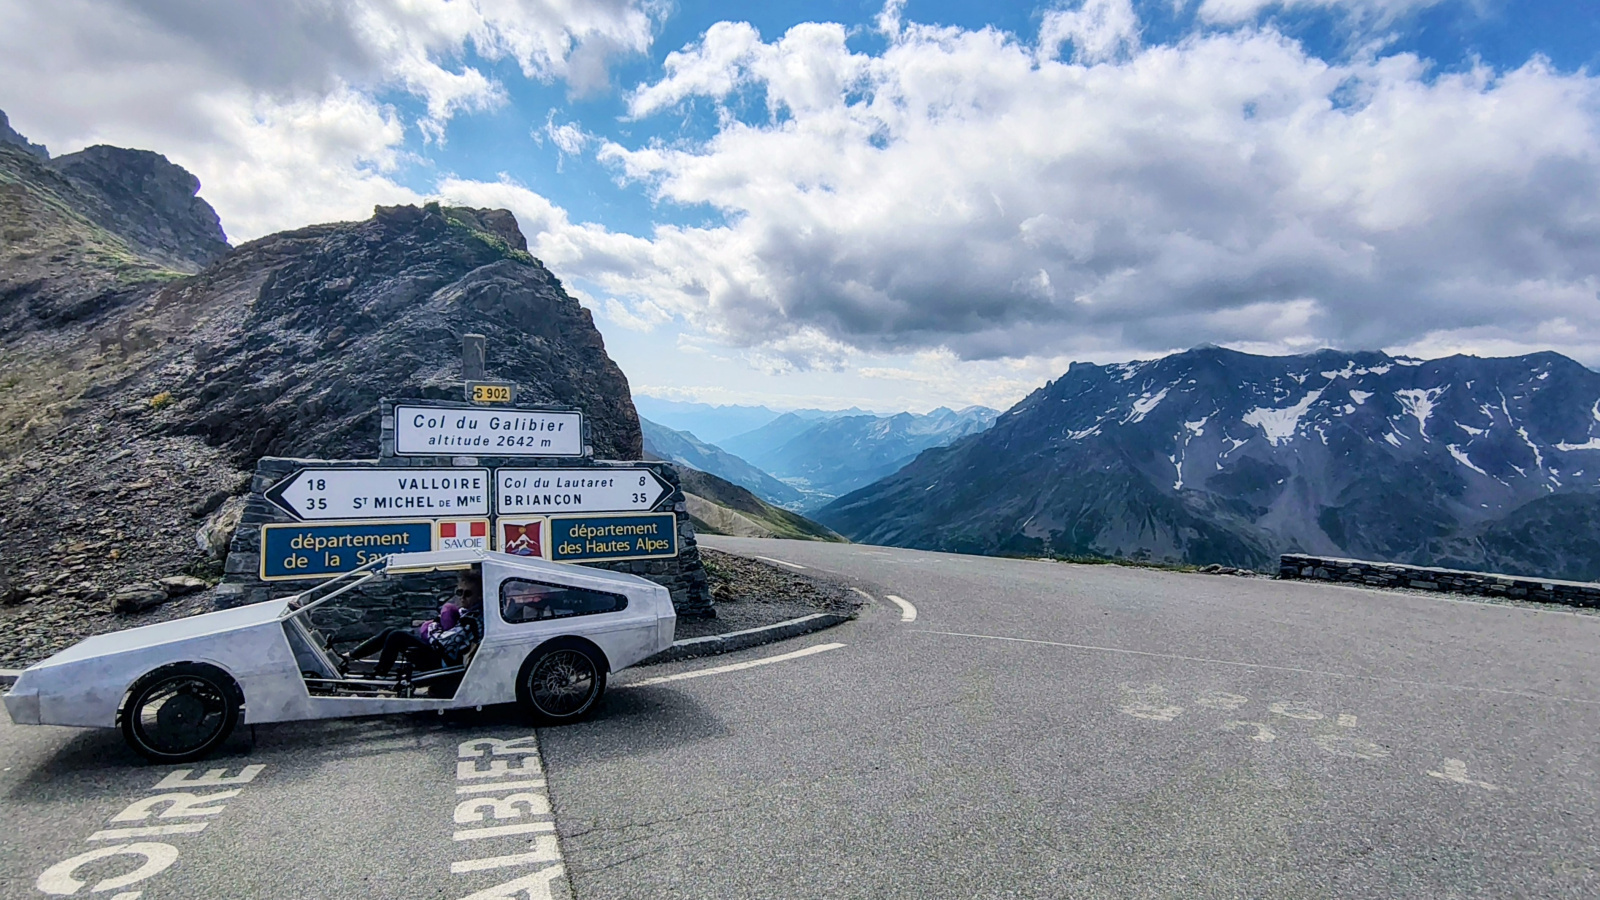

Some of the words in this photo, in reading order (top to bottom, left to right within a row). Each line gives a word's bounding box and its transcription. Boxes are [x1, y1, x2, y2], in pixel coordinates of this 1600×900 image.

[486, 387, 508, 399] 902
[413, 414, 446, 429] Col
[456, 416, 478, 430] du
[489, 416, 565, 432] Galibier
[428, 434, 490, 446] altitude
[496, 435, 534, 447] 2642
[540, 438, 552, 448] m
[307, 479, 326, 491] 18
[398, 478, 481, 490] VALLOIRE
[504, 477, 527, 489] Col
[533, 477, 550, 488] du
[556, 477, 614, 488] Lautaret
[638, 476, 646, 487] 8
[306, 498, 328, 510] 35
[374, 496, 435, 509] MICHEL
[439, 499, 451, 508] DE
[504, 493, 582, 506] BRIANÇON
[632, 492, 647, 504] 35
[569, 523, 658, 539] département
[290, 532, 410, 552] département
[444, 538, 482, 549] SAVOIE
[558, 541, 582, 555] des
[586, 540, 630, 553] Hautes
[635, 537, 669, 552] Alpes
[283, 553, 309, 569] de
[325, 551, 341, 567] la
[36, 763, 267, 900] OIRE
